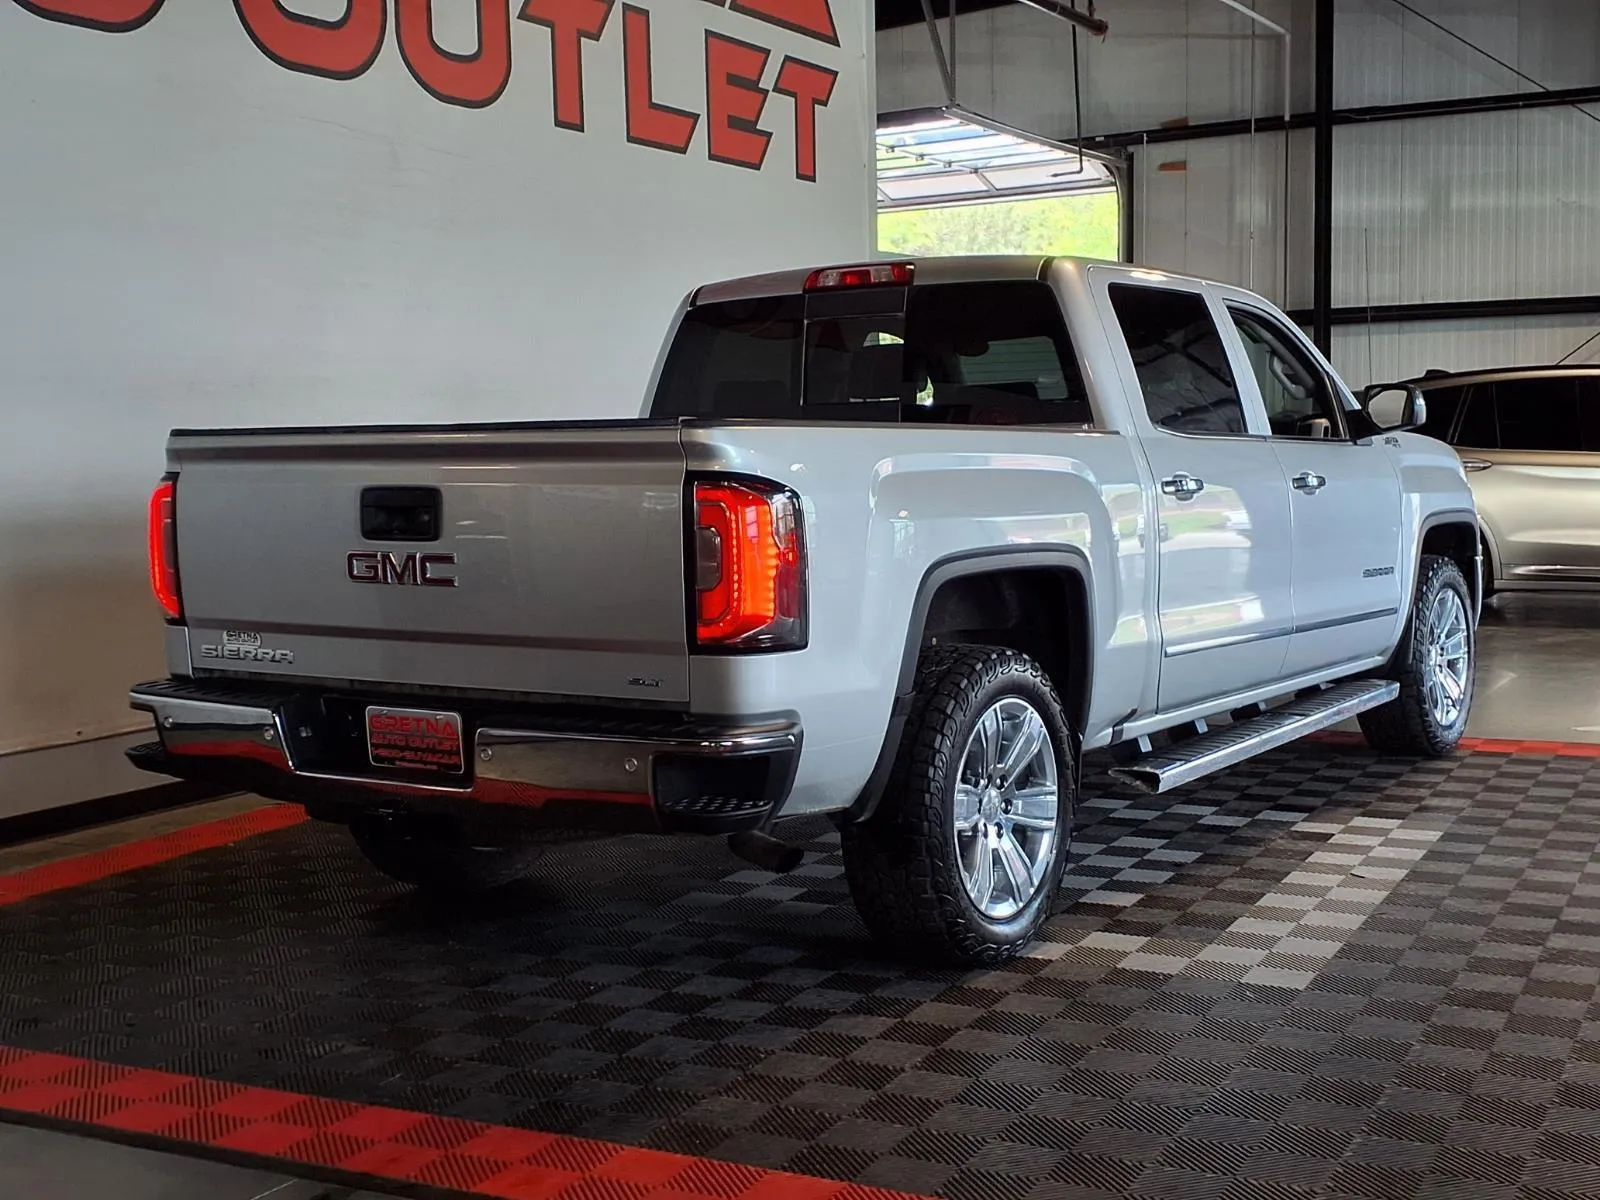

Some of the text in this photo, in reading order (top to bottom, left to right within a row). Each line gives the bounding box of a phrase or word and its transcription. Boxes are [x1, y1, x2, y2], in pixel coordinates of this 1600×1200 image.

[346, 550, 459, 587] GMC
[201, 644, 294, 664] SIERRA
[369, 714, 458, 738] GRETNA
